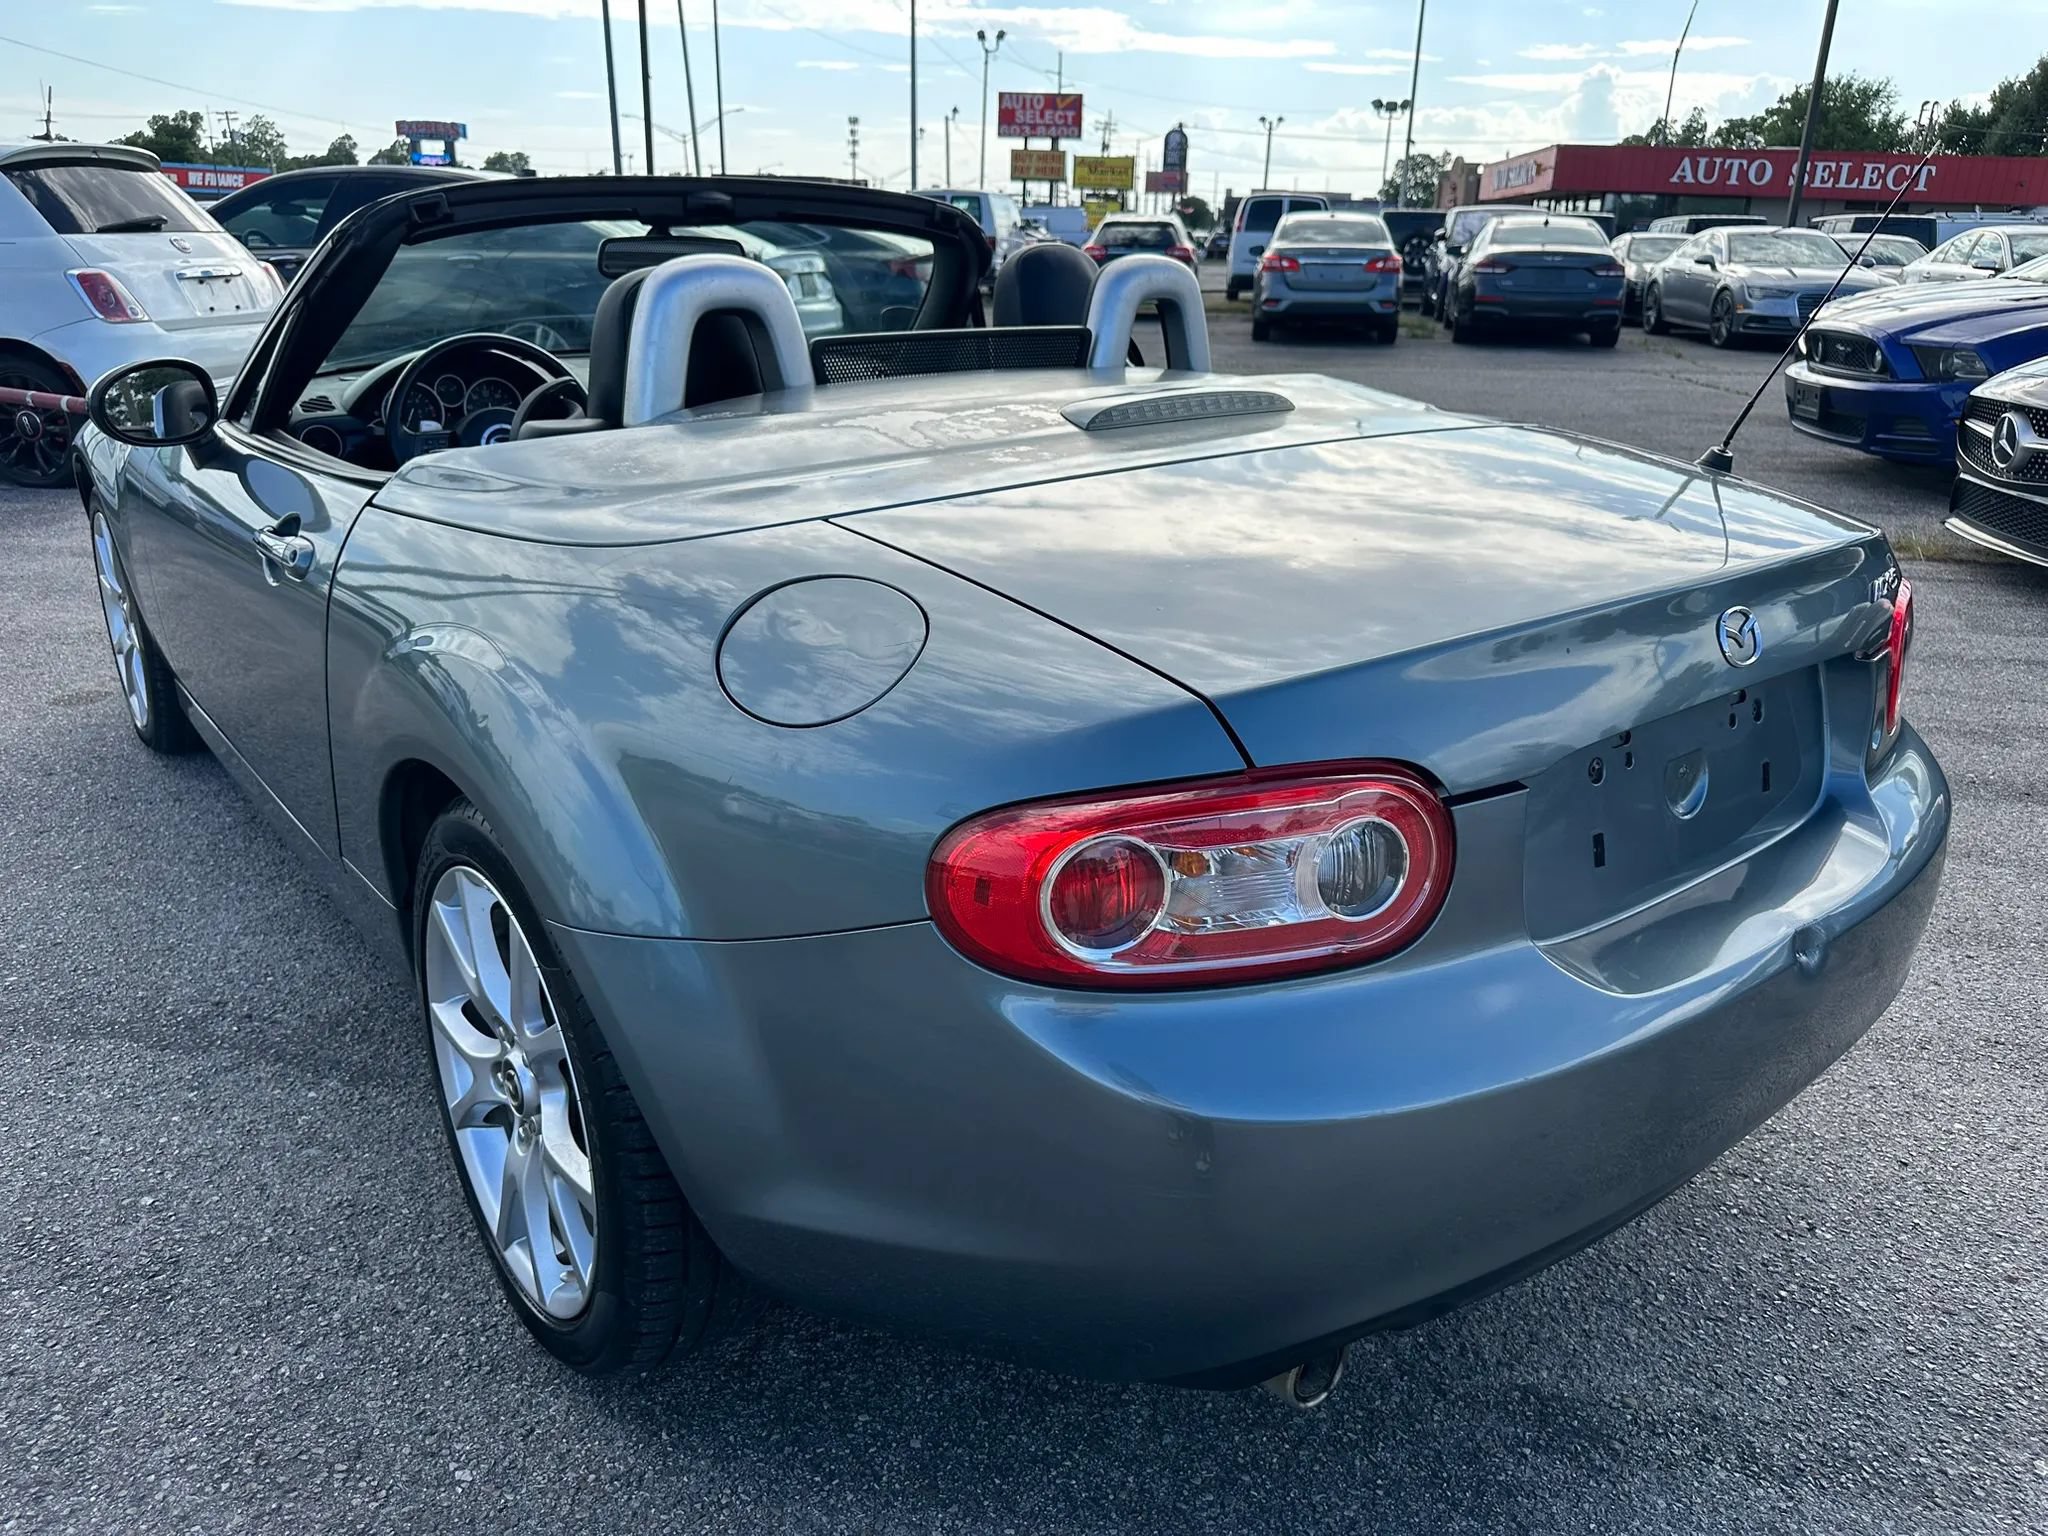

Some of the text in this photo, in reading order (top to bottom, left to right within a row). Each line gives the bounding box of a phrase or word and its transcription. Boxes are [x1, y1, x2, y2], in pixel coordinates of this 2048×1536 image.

[1001, 94, 1045, 110] AUTO
[1015, 109, 1075, 125] SELECT
[1669, 156, 1773, 186] AUTO
[188, 171, 203, 185] WE
[204, 172, 245, 188] FINANCE
